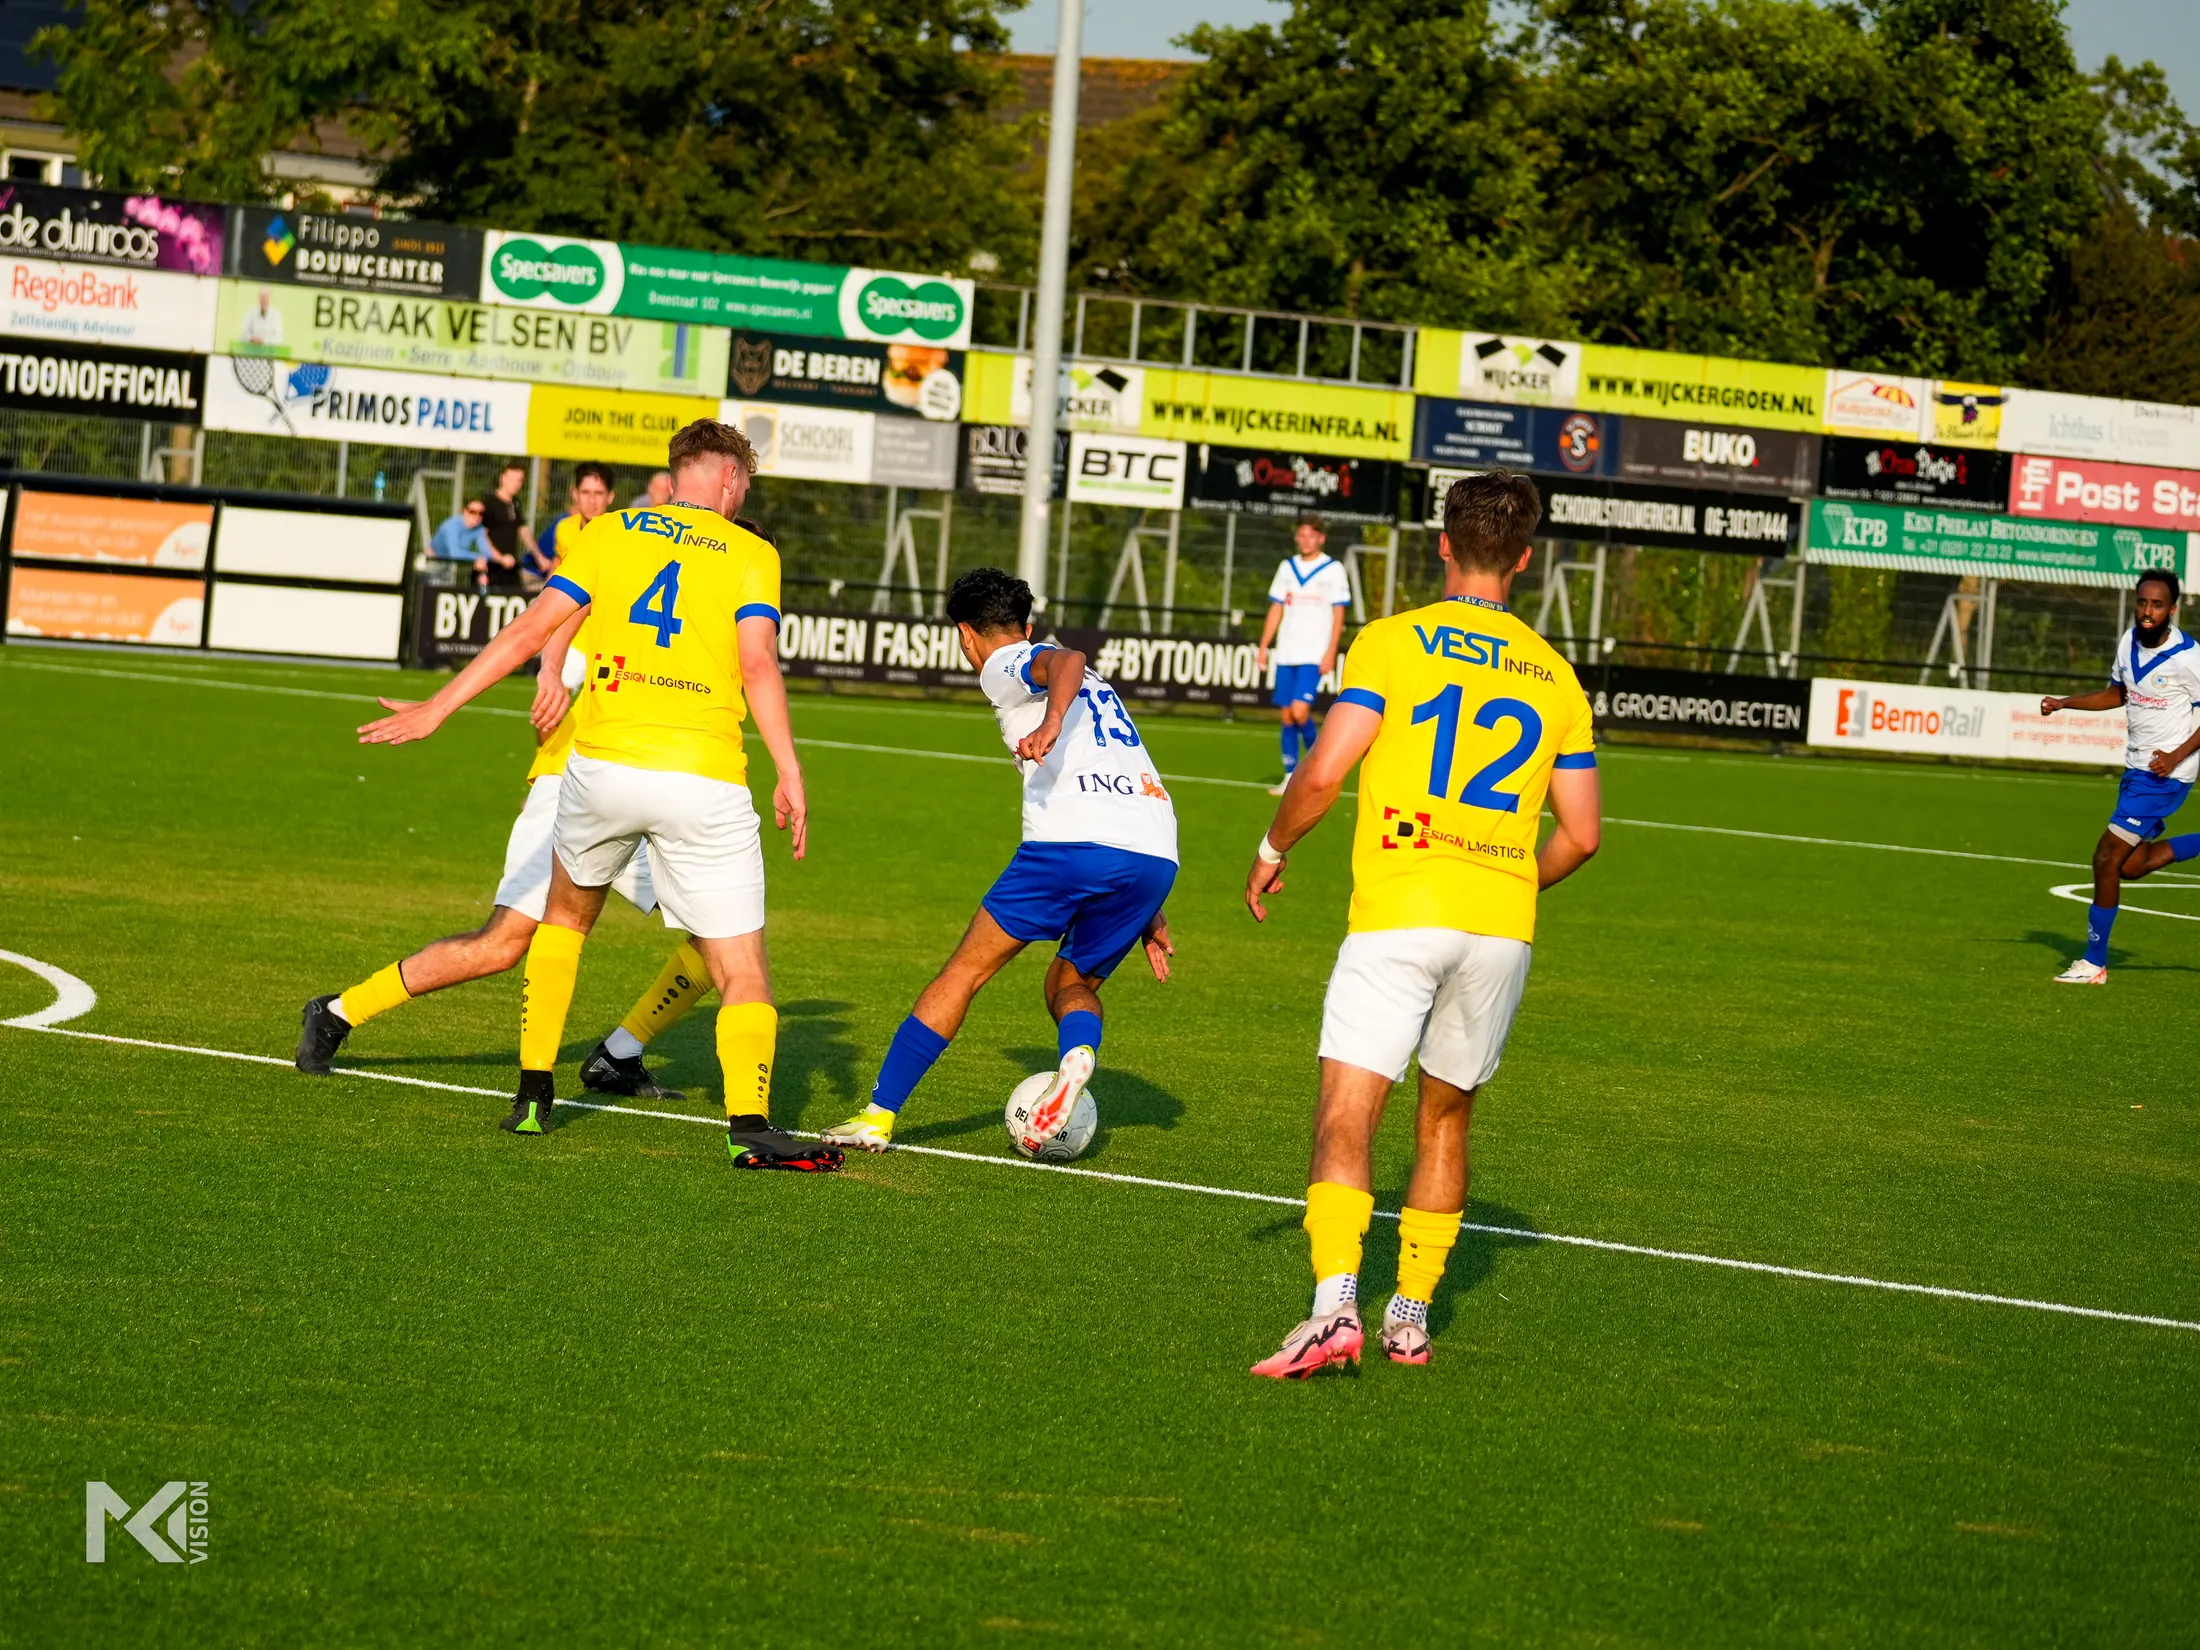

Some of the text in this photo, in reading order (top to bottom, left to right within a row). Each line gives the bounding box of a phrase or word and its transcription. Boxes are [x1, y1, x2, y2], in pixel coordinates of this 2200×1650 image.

[0, 202, 159, 260] de duinroos
[298, 215, 380, 251] Filippo
[295, 248, 444, 283] BOUWCENTER
[500, 253, 597, 287] Specsavers
[12, 265, 139, 311] RegioBank
[866, 291, 956, 323] Specsavers
[314, 294, 633, 356] BRAAK VELSEN BV
[773, 348, 881, 386] DE BEREN
[1483, 369, 1551, 389] WIJCKER
[311, 388, 494, 433] PRIMOS PADEL
[1587, 375, 1815, 416] WWW.WIJCKERGROEN.NL
[564, 407, 602, 426] JOIN
[610, 411, 634, 429] THE
[780, 422, 854, 452] SCHOORL
[1151, 400, 1401, 442] WWW.WIJCKERINFRA.NL
[2055, 471, 2140, 512] Post
[620, 511, 728, 554] VEST INFRA
[1843, 516, 1888, 547] KPB
[2132, 542, 2176, 570] KPB
[434, 592, 540, 640] BY TO
[629, 559, 682, 649] 4
[1478, 599, 1496, 610] ODIN
[778, 613, 868, 664] OMEN
[1412, 625, 1556, 685] VEST INFRA
[649, 676, 712, 694] LOGISTICS
[1079, 688, 1140, 747] 13
[1593, 691, 1802, 731] & GROENPROJECTEN
[1871, 700, 1985, 738] BemoRail
[1410, 683, 1543, 814] 12
[1077, 773, 1134, 795] ING
[1468, 841, 1526, 861] LOGISTICS
